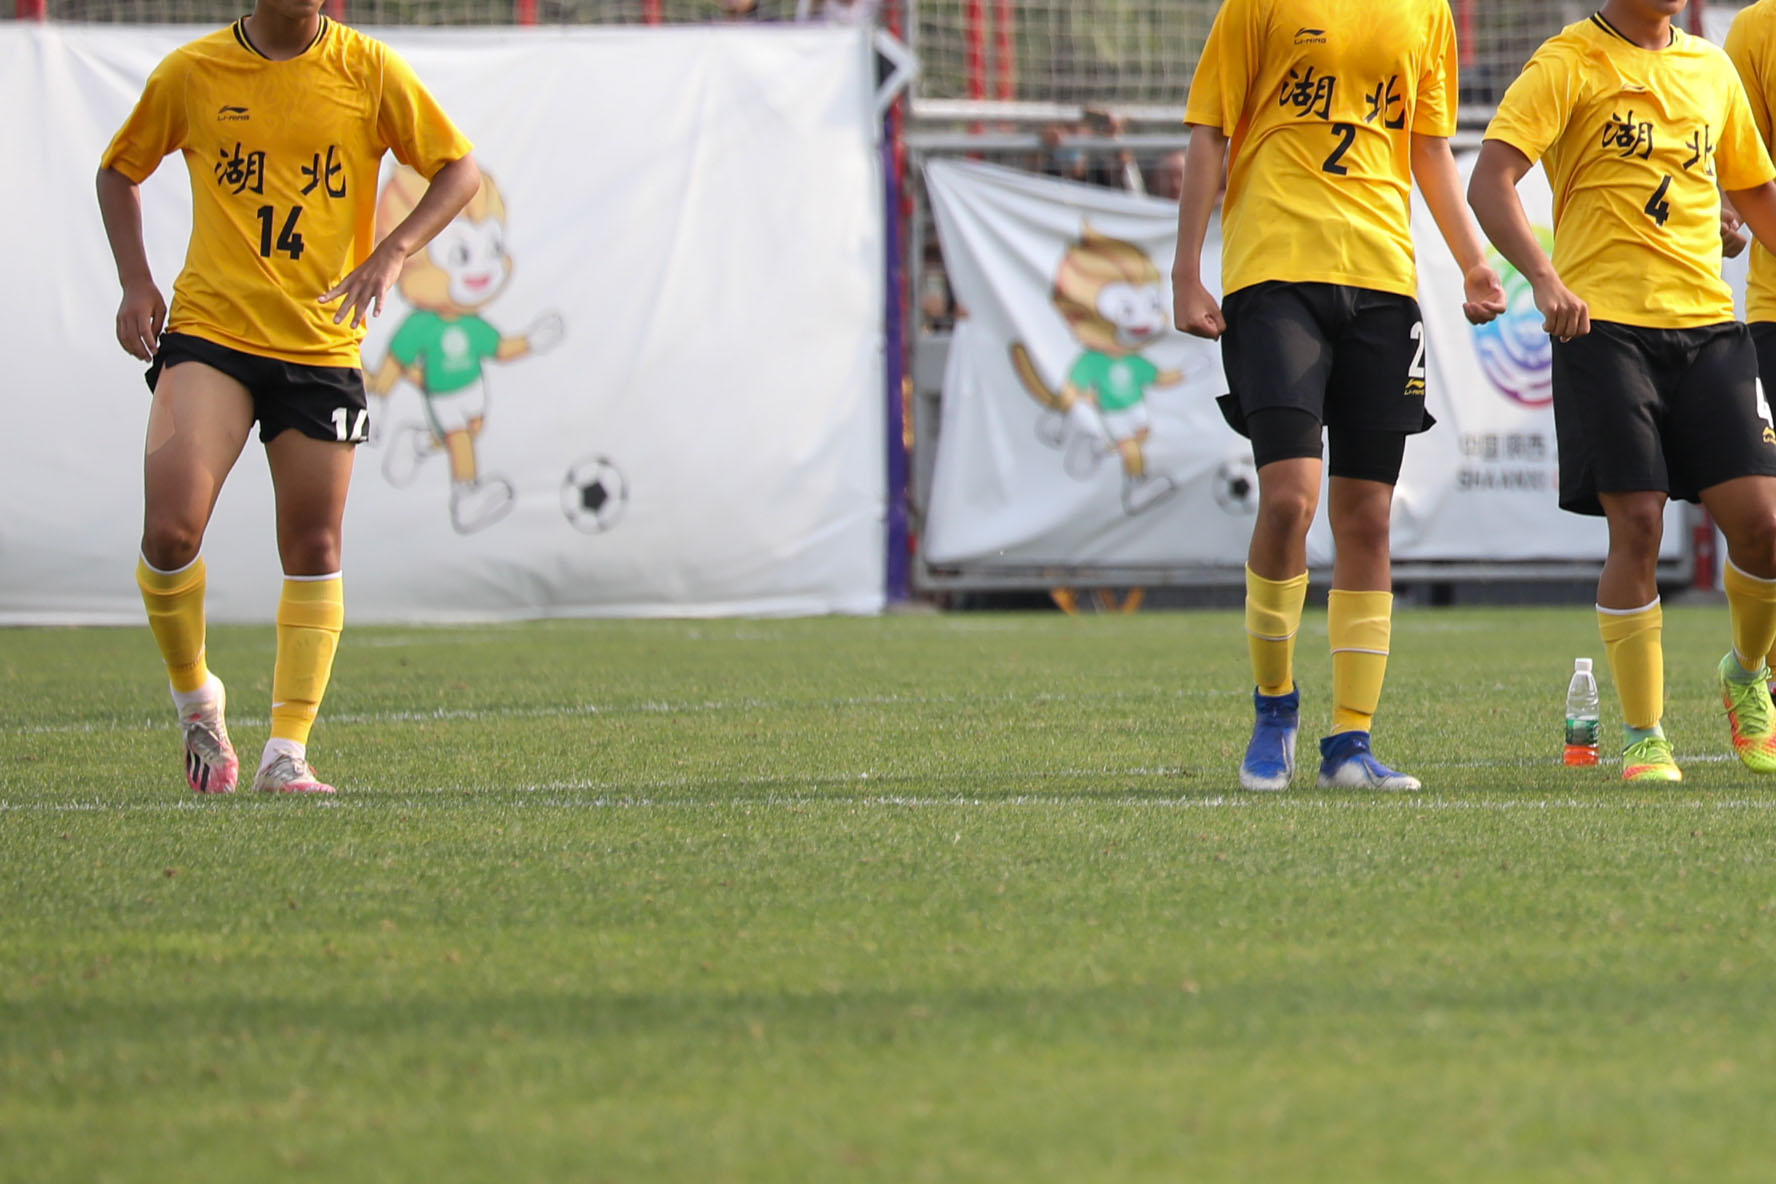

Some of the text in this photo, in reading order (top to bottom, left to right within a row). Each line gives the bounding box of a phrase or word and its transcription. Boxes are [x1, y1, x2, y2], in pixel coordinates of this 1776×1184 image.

[1279, 66, 1405, 130] 湖北
[214, 141, 347, 199] 湖北
[1322, 123, 1356, 176] 2
[1645, 174, 1672, 227] 4
[257, 205, 305, 260] 14
[1408, 320, 1426, 378] 2
